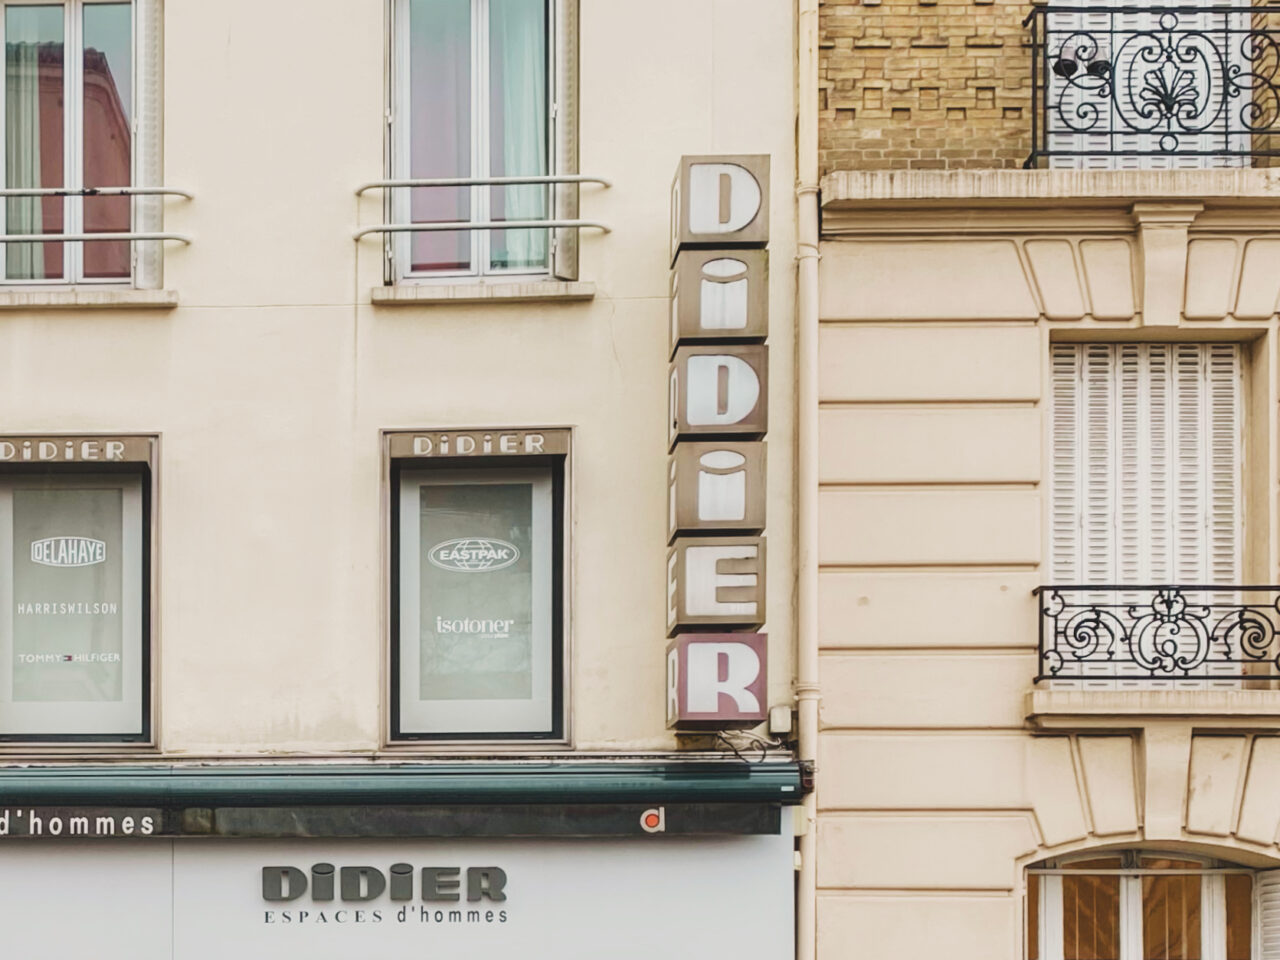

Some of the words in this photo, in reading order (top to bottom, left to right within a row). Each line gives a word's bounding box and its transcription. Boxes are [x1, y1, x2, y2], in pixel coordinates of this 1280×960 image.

[413, 434, 545, 456] DiDiER
[34, 540, 103, 564] DELAHAYE
[439, 549, 510, 561] EASTPAK
[17, 602, 118, 615] HARRISWILSON
[436, 616, 515, 634] isotoner
[18, 653, 62, 663] TOMMY
[74, 652, 121, 663] HILFIGER
[261, 862, 508, 902] DiDiER
[263, 910, 384, 924] ESPACES
[396, 905, 508, 924] d'hommes
